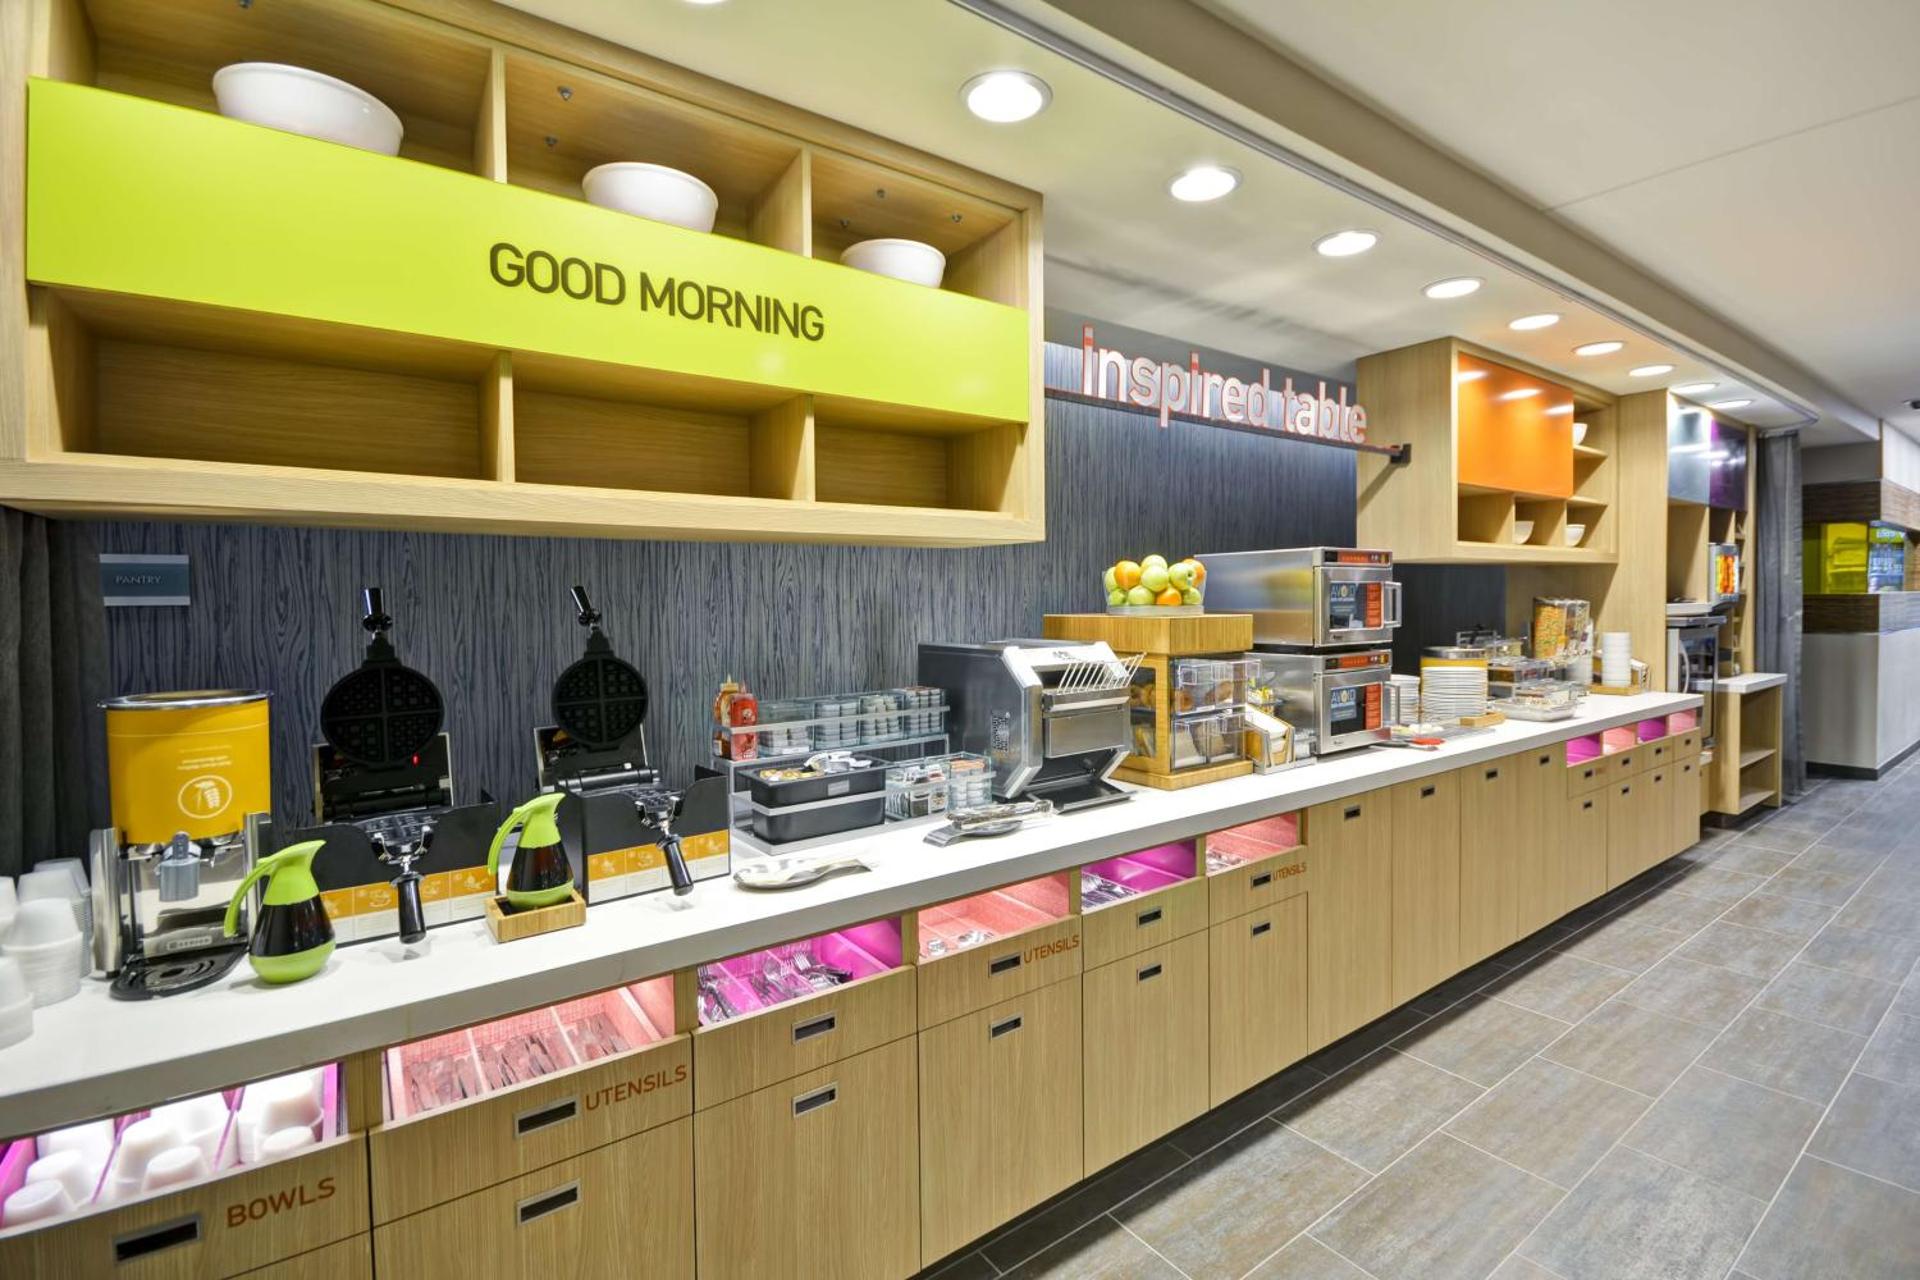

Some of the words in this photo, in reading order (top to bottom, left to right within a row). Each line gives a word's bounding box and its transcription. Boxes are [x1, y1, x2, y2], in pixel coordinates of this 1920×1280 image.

[489, 242, 626, 306] GOOD
[639, 271, 825, 342] MORNING
[1082, 323, 1271, 427] inspired
[1283, 376, 1368, 444] table
[115, 575, 162, 585] PANTRY
[1273, 862, 1306, 880] UTENSILS
[1023, 934, 1080, 964] UTENSILS
[585, 1064, 687, 1111] UTENSILS
[227, 1176, 336, 1228] BOWLS
